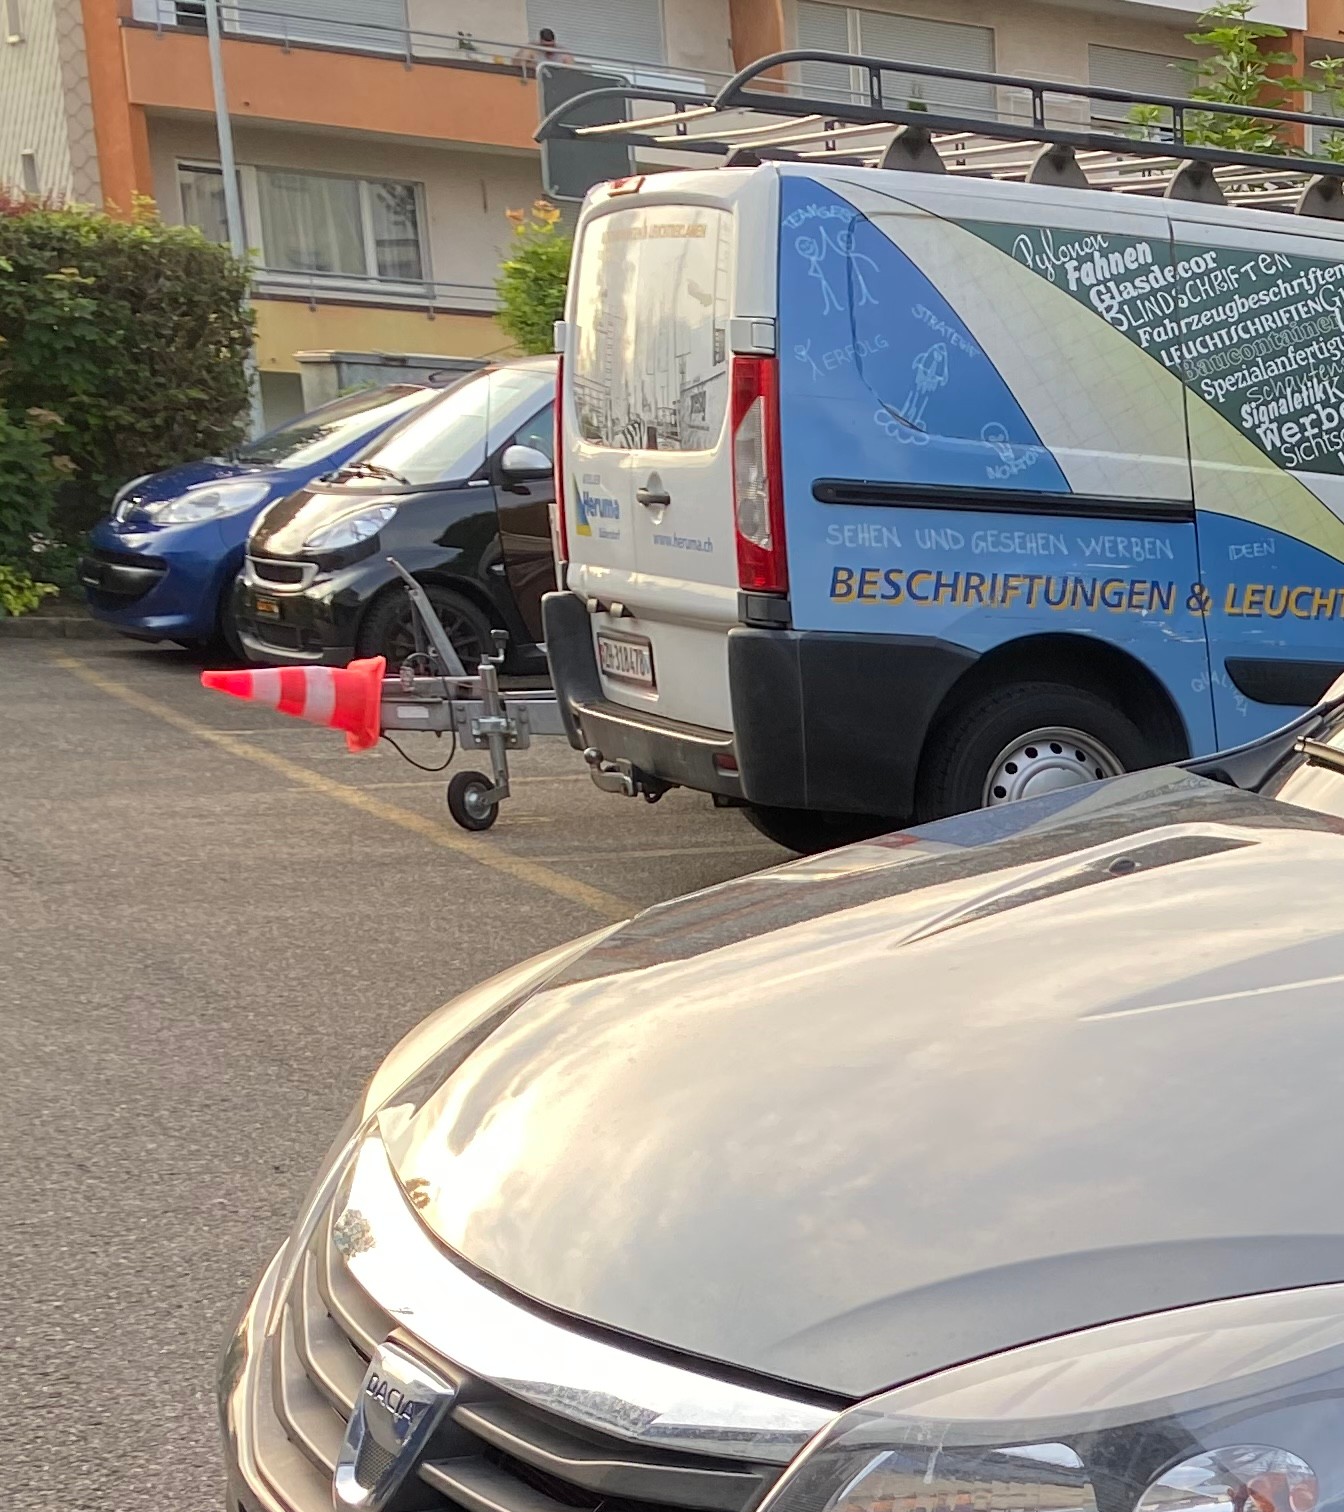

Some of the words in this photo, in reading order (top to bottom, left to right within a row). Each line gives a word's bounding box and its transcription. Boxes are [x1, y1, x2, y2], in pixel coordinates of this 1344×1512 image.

[1012, 228, 1109, 282] Pylonen
[1064, 241, 1153, 291] Fahnen
[1089, 250, 1218, 306] Glasdecor
[822, 334, 890, 371] ERFOLG
[1181, 313, 1339, 382] Baucontainer
[1240, 377, 1328, 430] Signaletik
[653, 533, 713, 552] www.heruma.ch
[826, 523, 902, 549] SEHEN
[915, 528, 965, 551] UND
[971, 529, 1069, 556] GESEHEN
[1077, 534, 1174, 562] WERBEN
[829, 566, 1177, 615] BESCHRIFTUNGEN
[1186, 581, 1212, 618] &
[365, 1372, 413, 1424] DACIA
